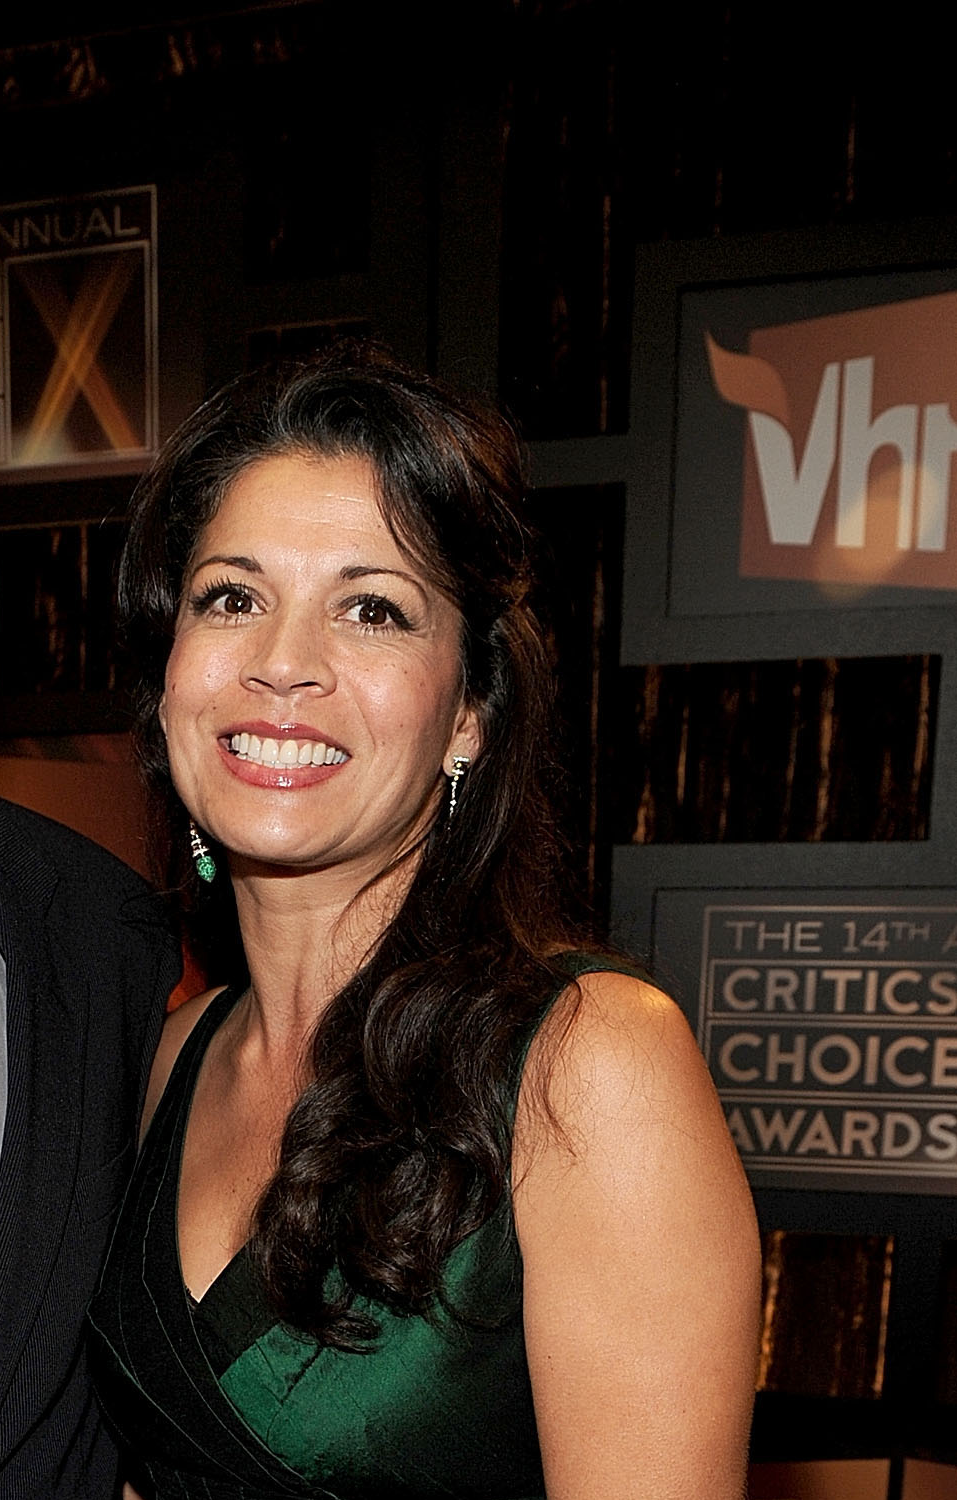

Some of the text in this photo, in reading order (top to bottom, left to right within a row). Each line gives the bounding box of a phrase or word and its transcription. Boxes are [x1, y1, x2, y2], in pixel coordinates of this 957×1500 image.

[725, 919, 824, 954] THE
[722, 966, 957, 1016] CRITICS
[718, 1031, 957, 1089] CHOICE
[726, 1106, 957, 1160] AWARDS
